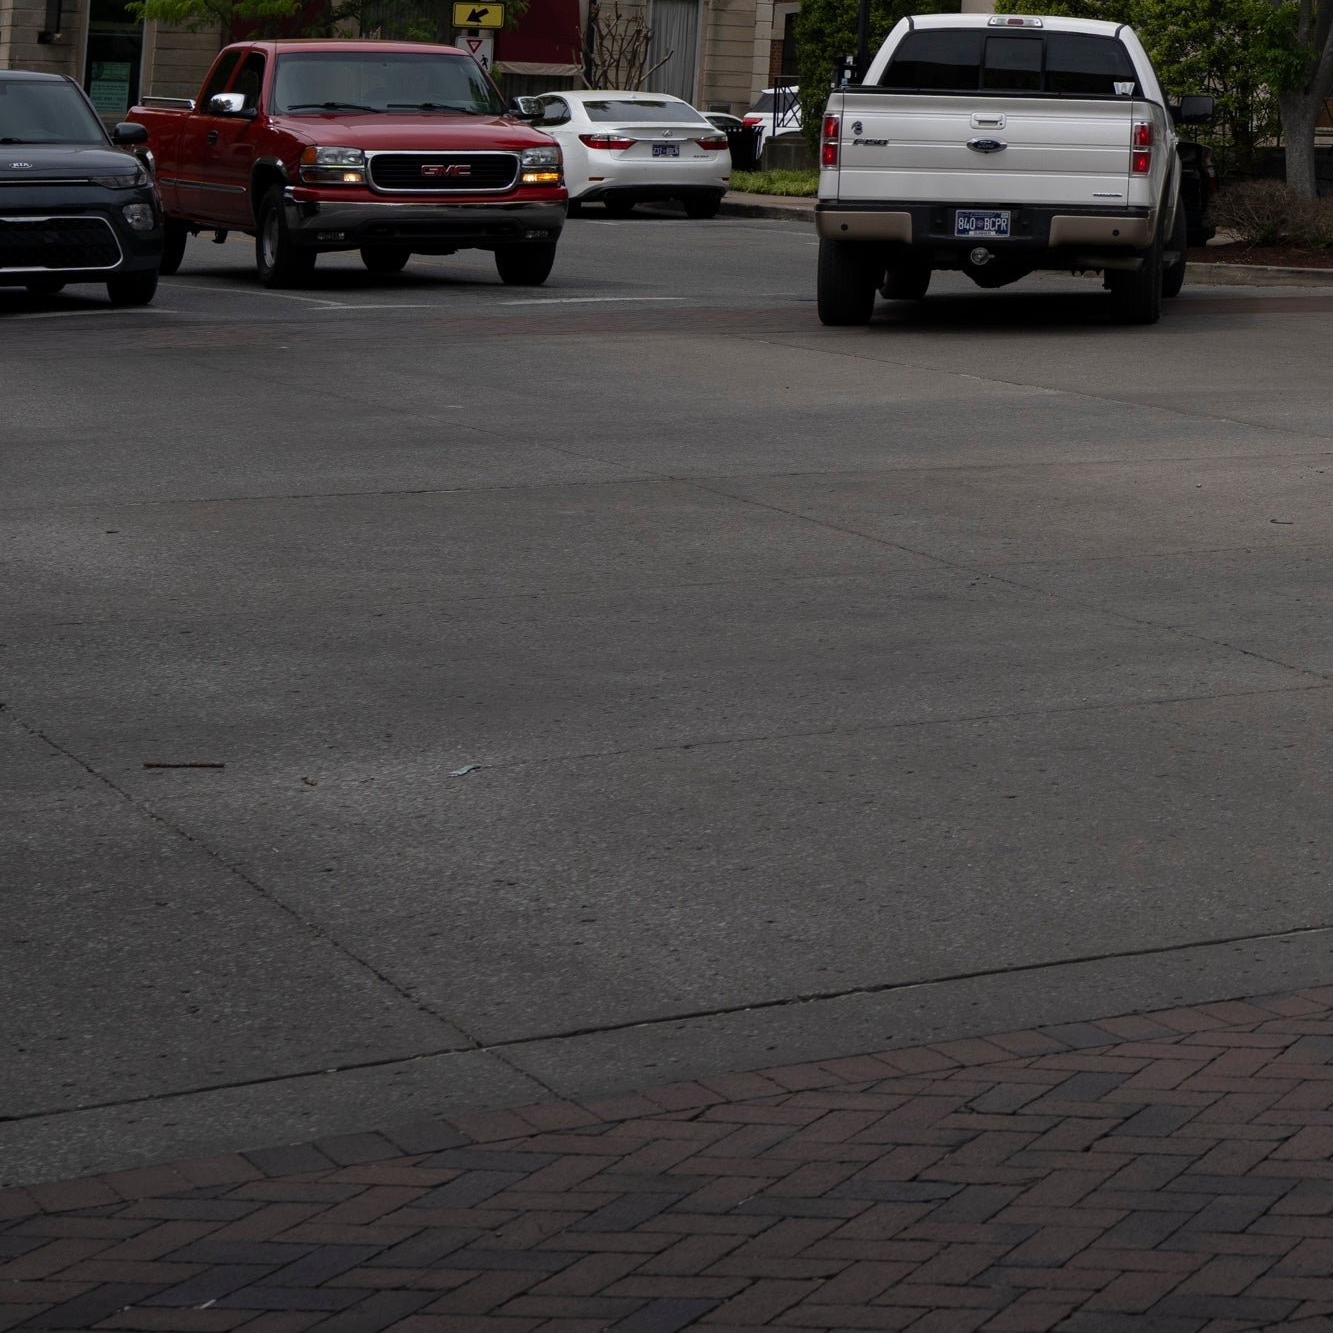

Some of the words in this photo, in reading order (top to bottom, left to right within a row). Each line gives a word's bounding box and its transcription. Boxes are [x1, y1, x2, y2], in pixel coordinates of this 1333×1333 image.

[420, 164, 472, 177] GMC
[958, 217, 976, 230] 840
[984, 217, 1008, 231] BCPR
